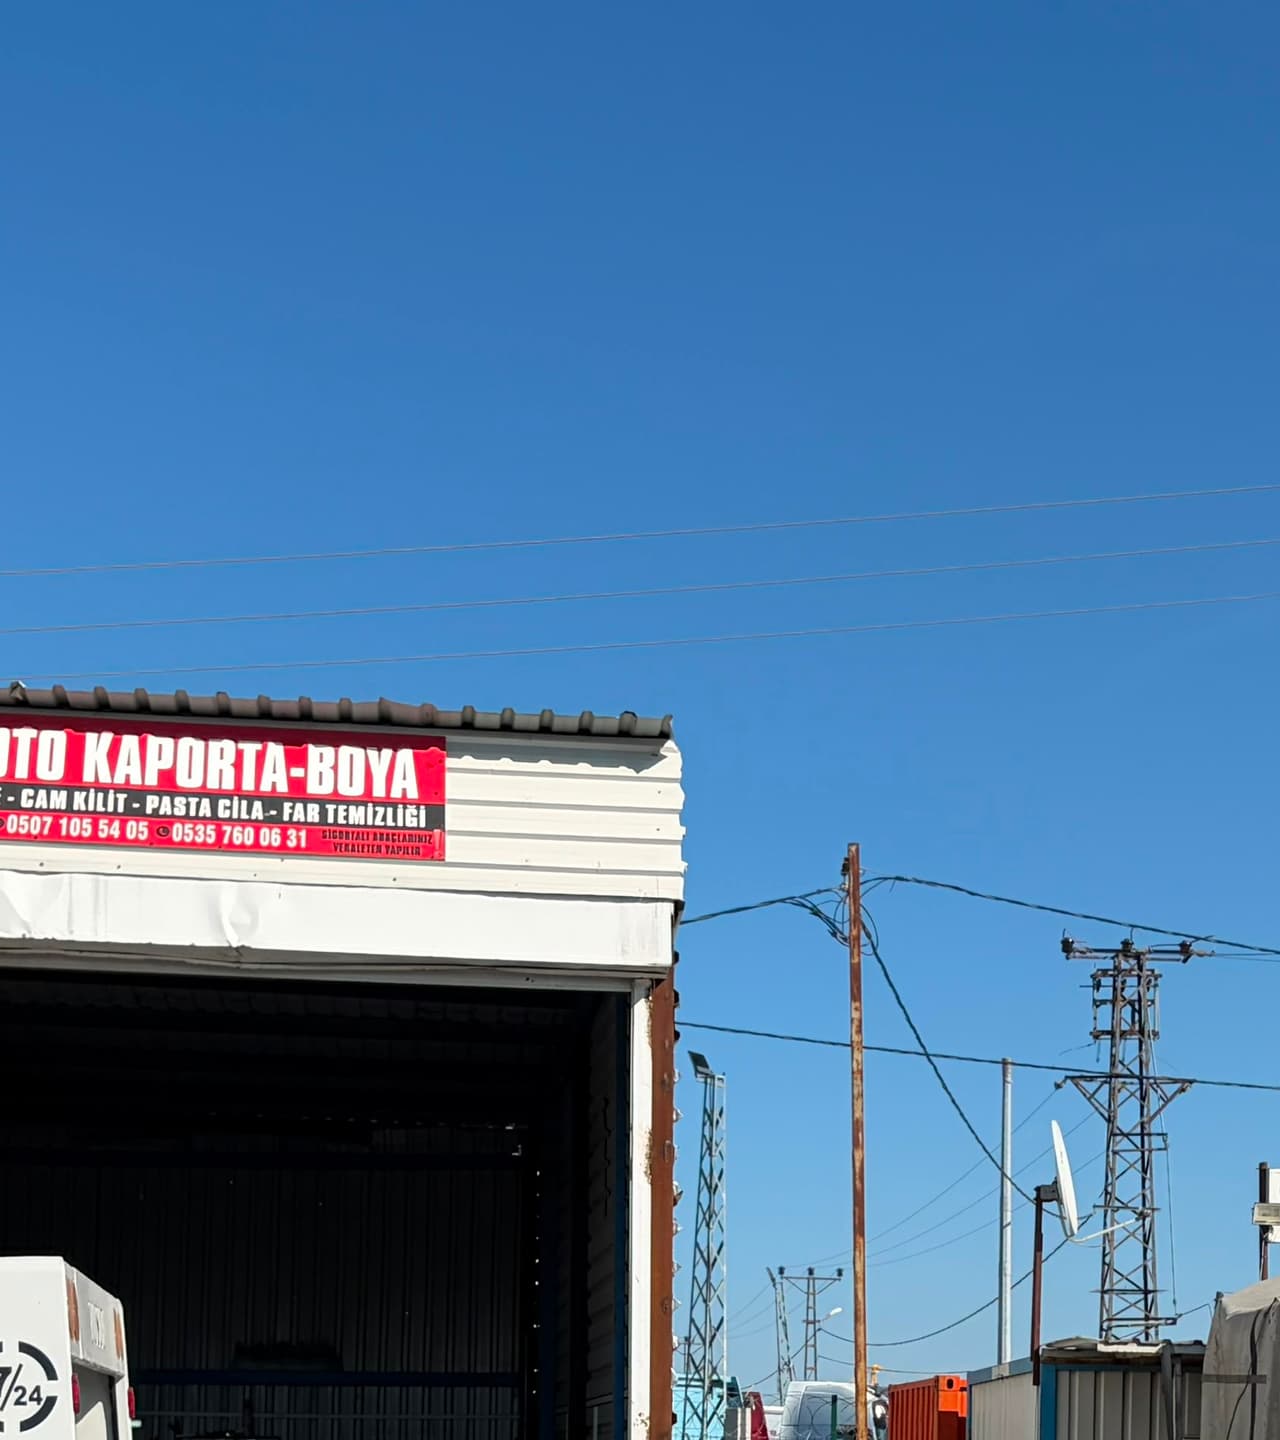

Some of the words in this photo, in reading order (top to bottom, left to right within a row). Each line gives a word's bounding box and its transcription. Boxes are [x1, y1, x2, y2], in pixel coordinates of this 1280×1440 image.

[82, 731, 419, 799] KAPORTA-BOYA
[20, 788, 67, 810] CAM
[73, 789, 127, 813] KİLİT
[145, 795, 211, 818] PASTA
[218, 796, 264, 820] CİLA
[282, 802, 319, 823] FAR
[326, 802, 426, 828] TEMİZLİĞİ
[6, 814, 53, 836] 0507
[60, 816, 92, 838] 105
[98, 818, 120, 839] 54
[126, 820, 149, 841] 05
[172, 822, 216, 844] 0535
[223, 825, 254, 846] 760
[259, 826, 282, 847] 06
[287, 828, 307, 848] 31
